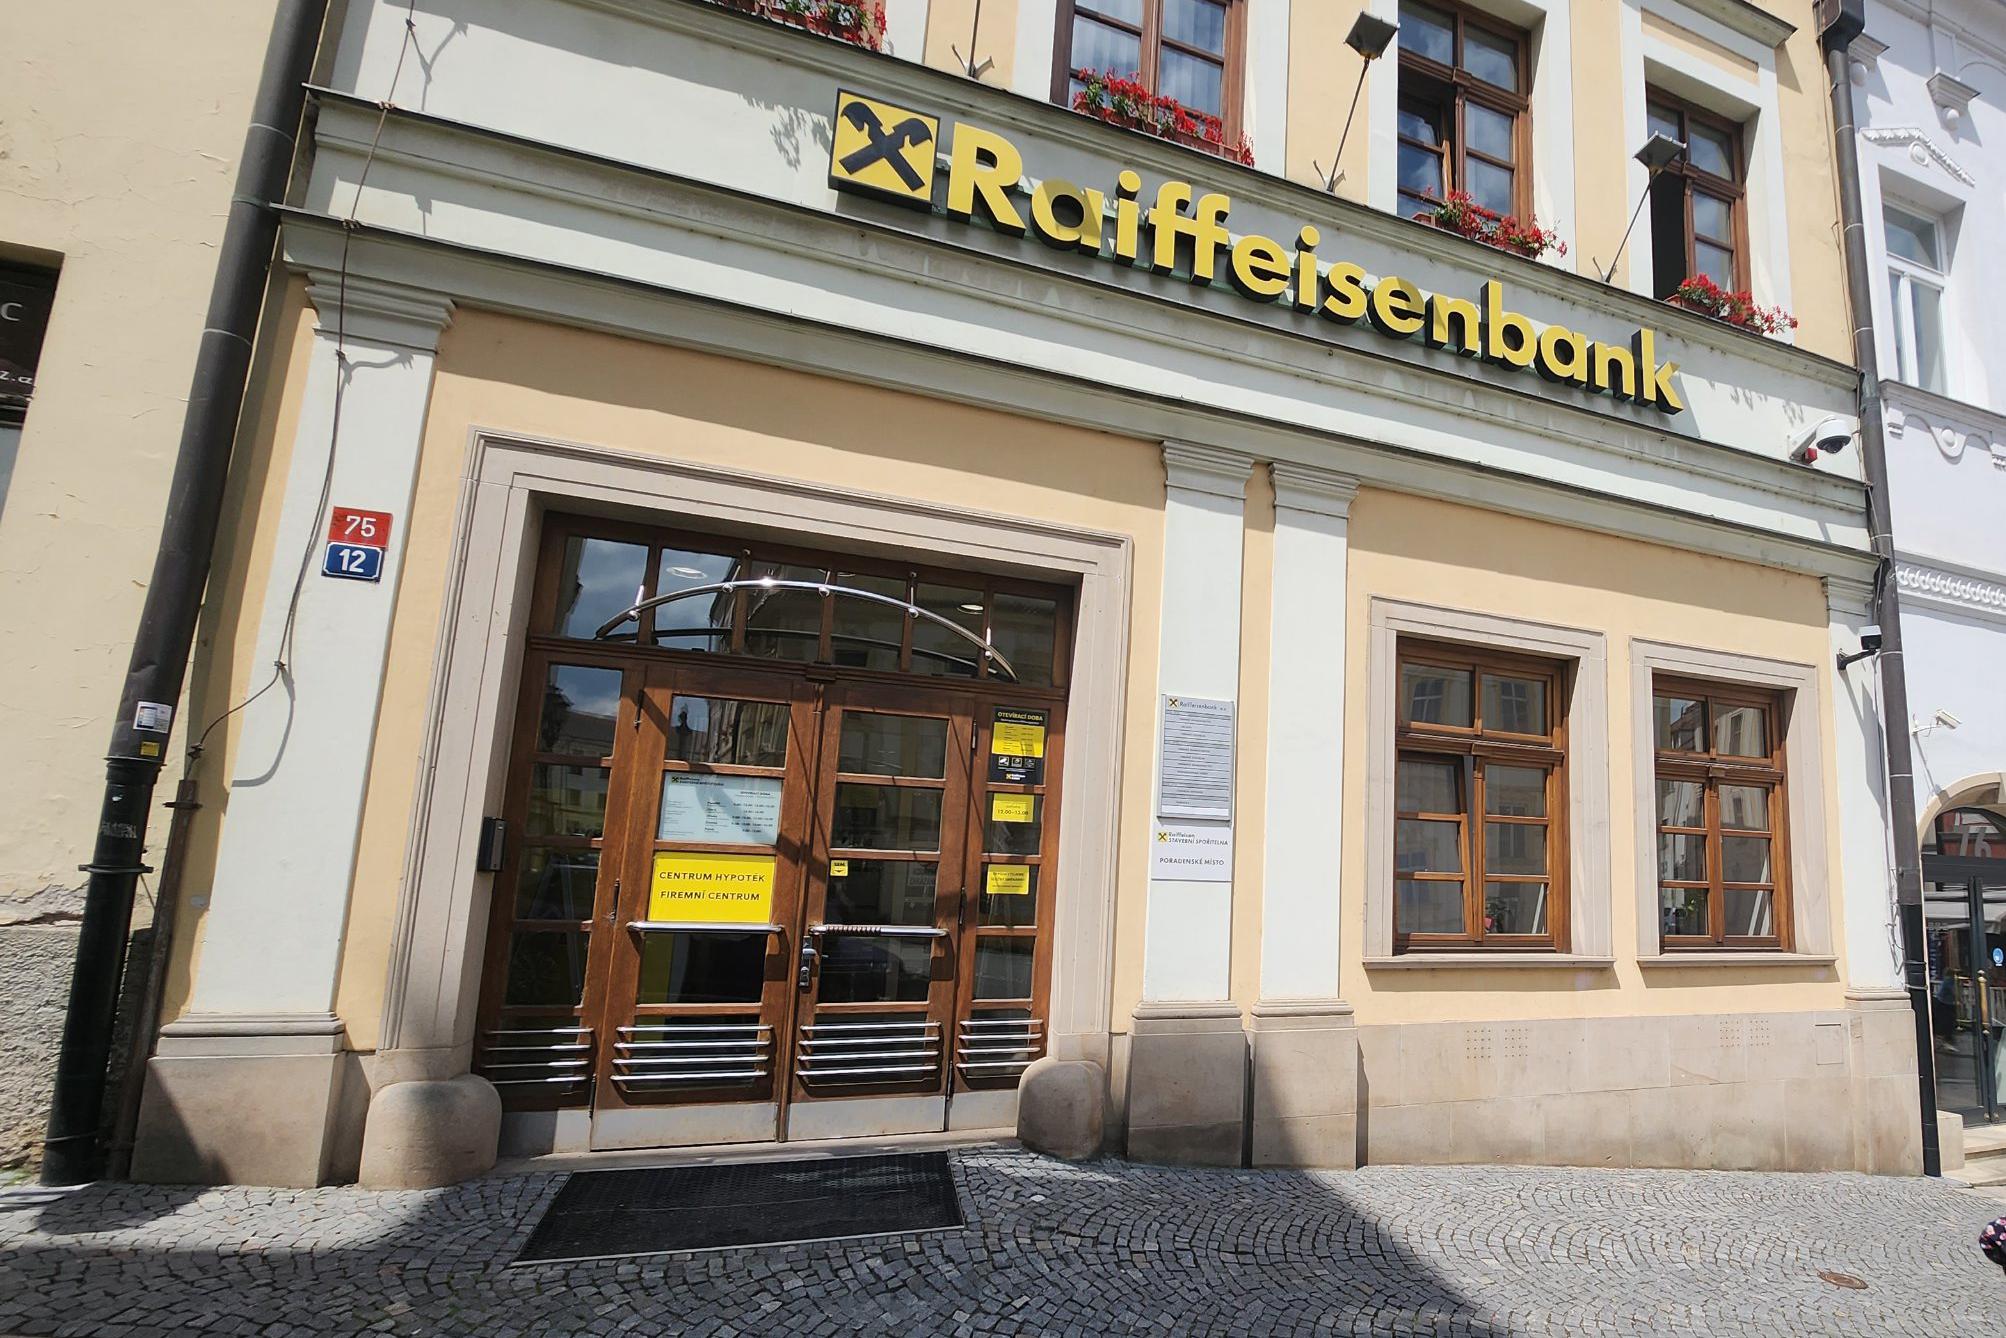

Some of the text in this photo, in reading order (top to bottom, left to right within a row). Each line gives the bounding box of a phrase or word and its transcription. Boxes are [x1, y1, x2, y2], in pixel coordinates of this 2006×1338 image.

[946, 121, 1684, 415] Raiffeisenbank
[344, 515, 377, 537] 75
[339, 548, 367, 573] 12
[1159, 857, 1224, 866] PORADENSKÉ MÍSTO
[659, 871, 765, 883] CENTRUM HYPOTÉK
[660, 889, 760, 901] FIREMNÍ CENTRUM
